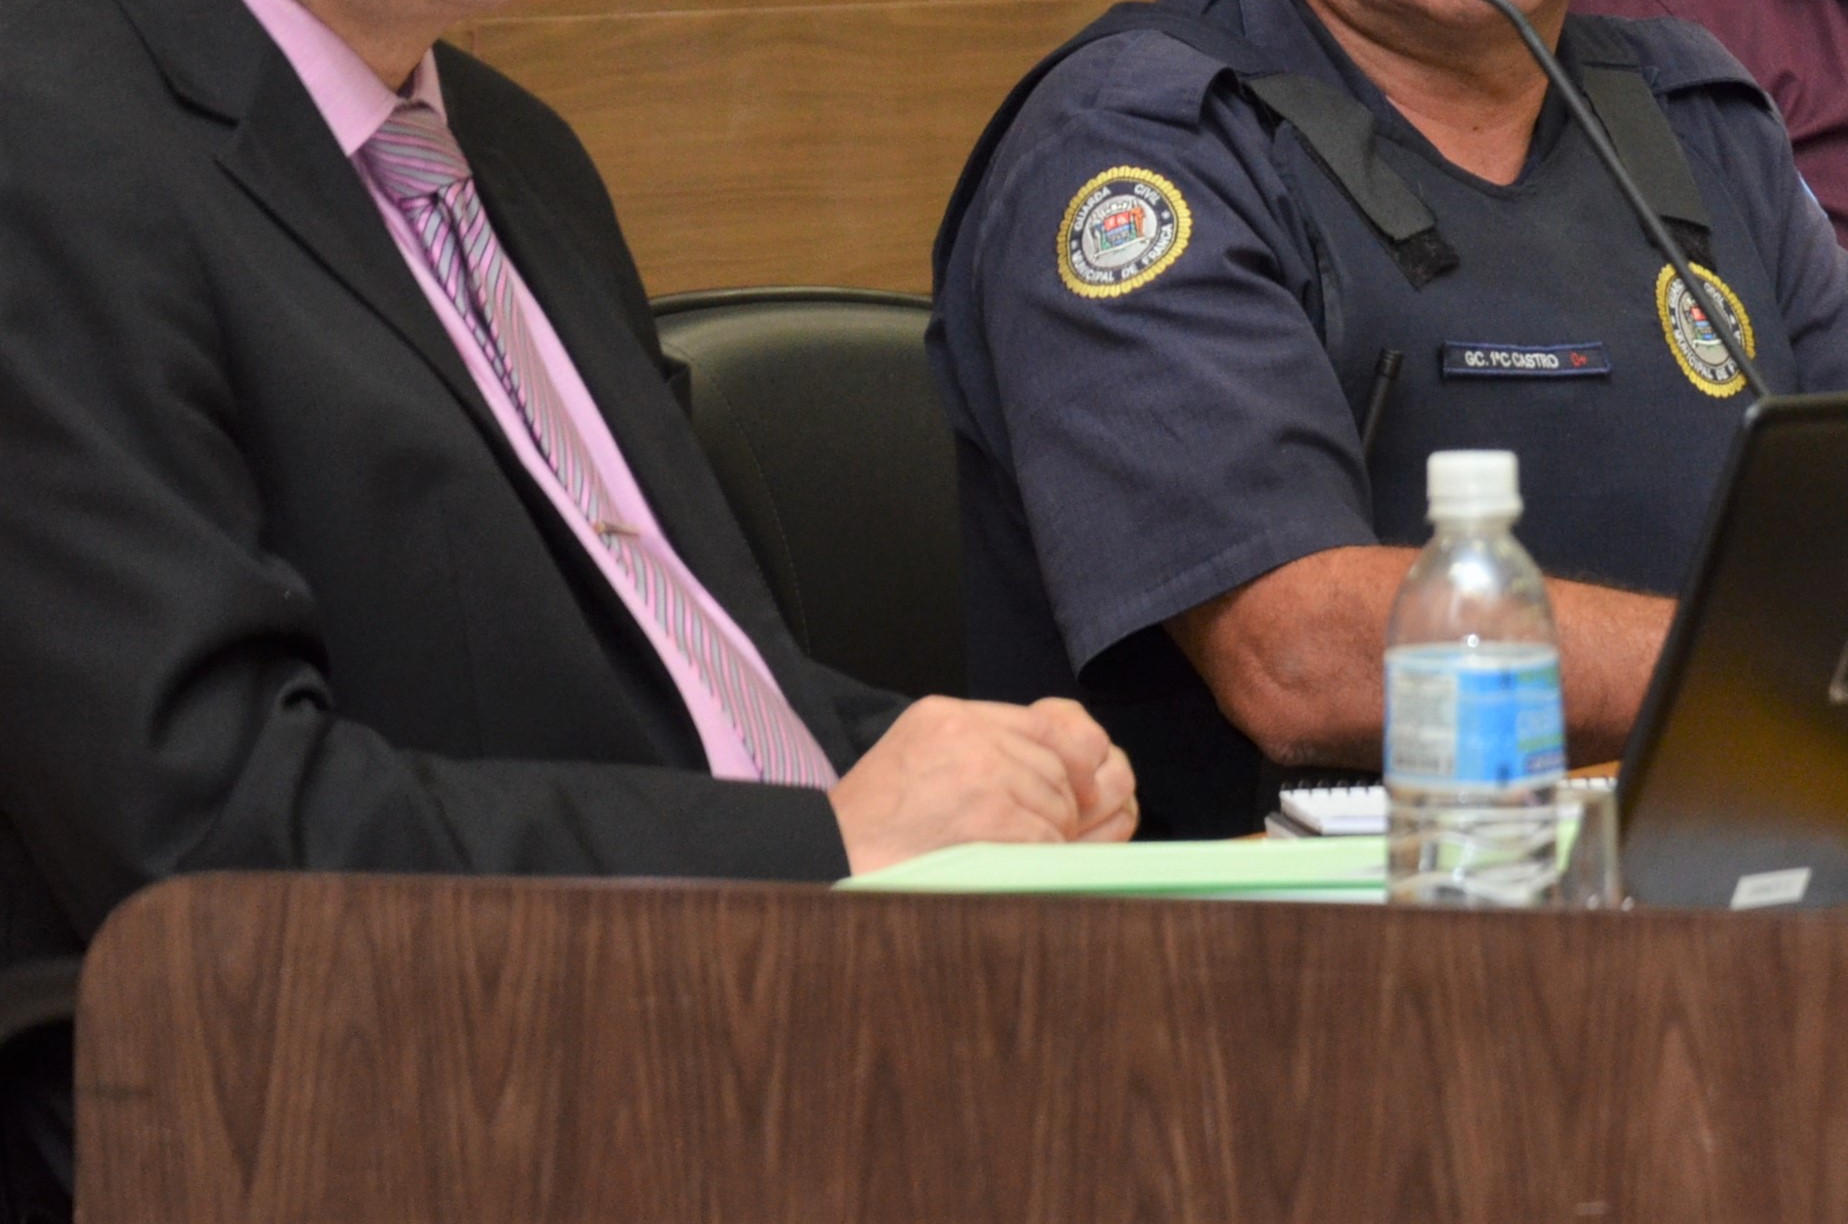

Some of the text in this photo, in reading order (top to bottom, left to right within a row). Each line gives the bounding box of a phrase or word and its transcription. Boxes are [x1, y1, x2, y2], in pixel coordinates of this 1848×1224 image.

[1074, 183, 1160, 231] GUARDA CIVIL
[1072, 250, 1114, 282] MUNICIPAL
[1121, 264, 1138, 279] DE
[1464, 350, 1488, 367] GC.
[1511, 352, 1559, 368] CASTRO
